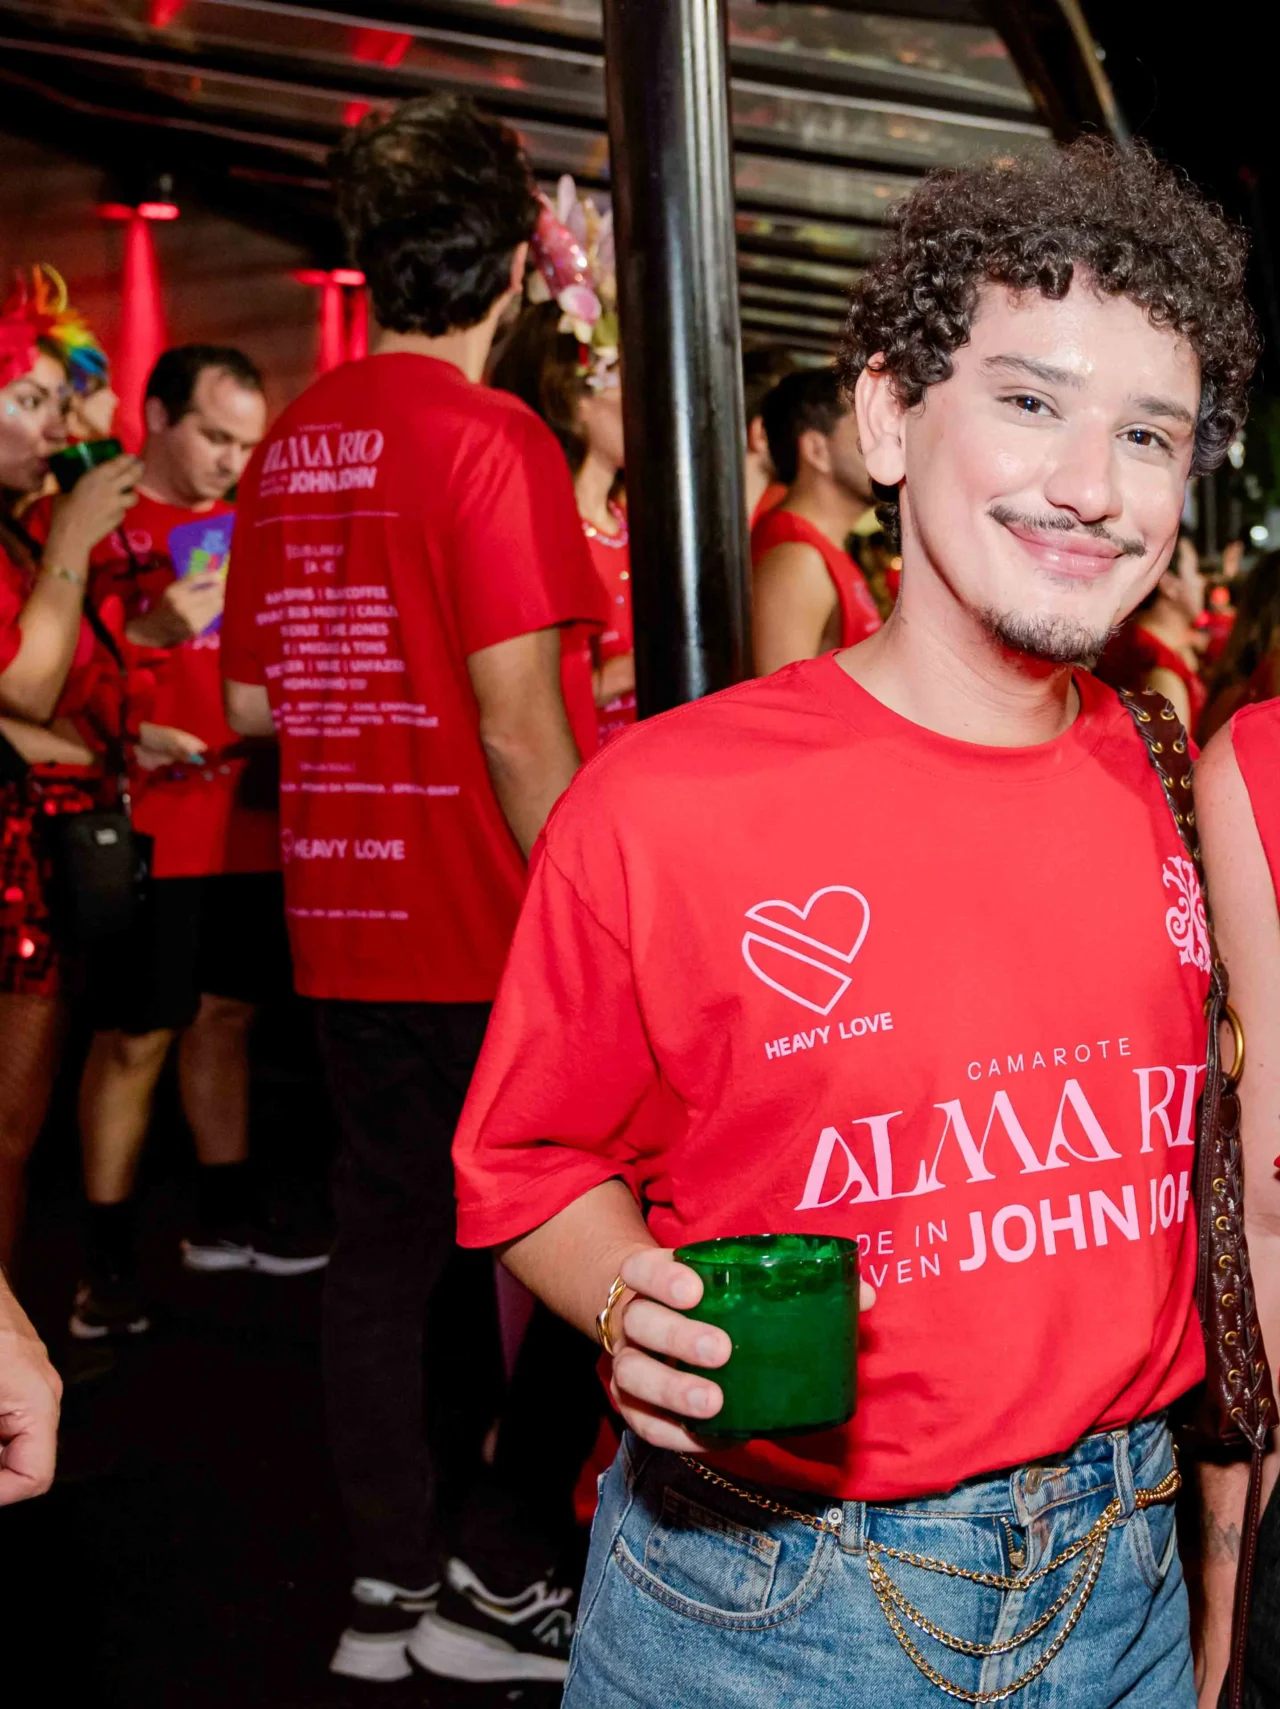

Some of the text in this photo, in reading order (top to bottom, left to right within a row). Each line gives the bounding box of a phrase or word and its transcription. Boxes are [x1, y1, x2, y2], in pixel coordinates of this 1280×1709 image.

[337, 429, 384, 465] RIO
[288, 470, 338, 494] JOHN
[294, 838, 406, 860] HEAVY LOVE
[765, 1011, 893, 1060] HEAVY LOVE
[967, 1037, 1132, 1081] CAMAROTE
[794, 1063, 1207, 1211] ALMA RI
[856, 1169, 1190, 1272] DE IN JOHN JOH
[869, 1253, 941, 1289] VEN
